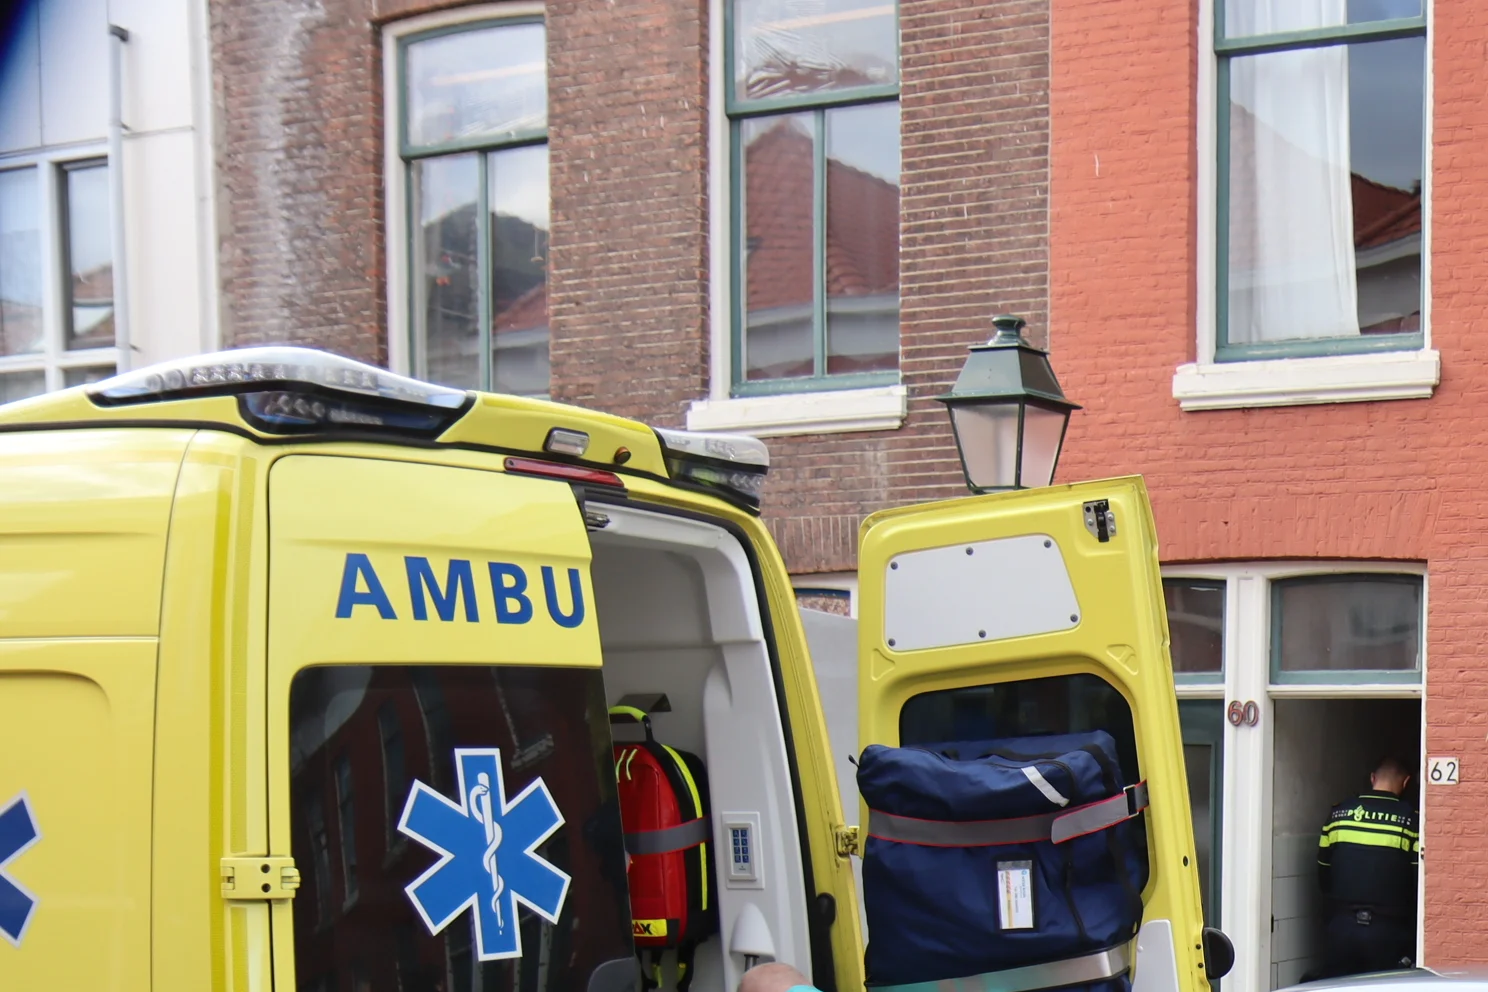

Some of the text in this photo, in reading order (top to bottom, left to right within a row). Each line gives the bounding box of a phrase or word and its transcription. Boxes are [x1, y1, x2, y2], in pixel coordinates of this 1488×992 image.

[335, 552, 585, 628] AMBU
[1228, 700, 1259, 727] 60
[1430, 761, 1457, 781] 62
[1347, 805, 1397, 821] POLITIE
[632, 921, 653, 935] AX
